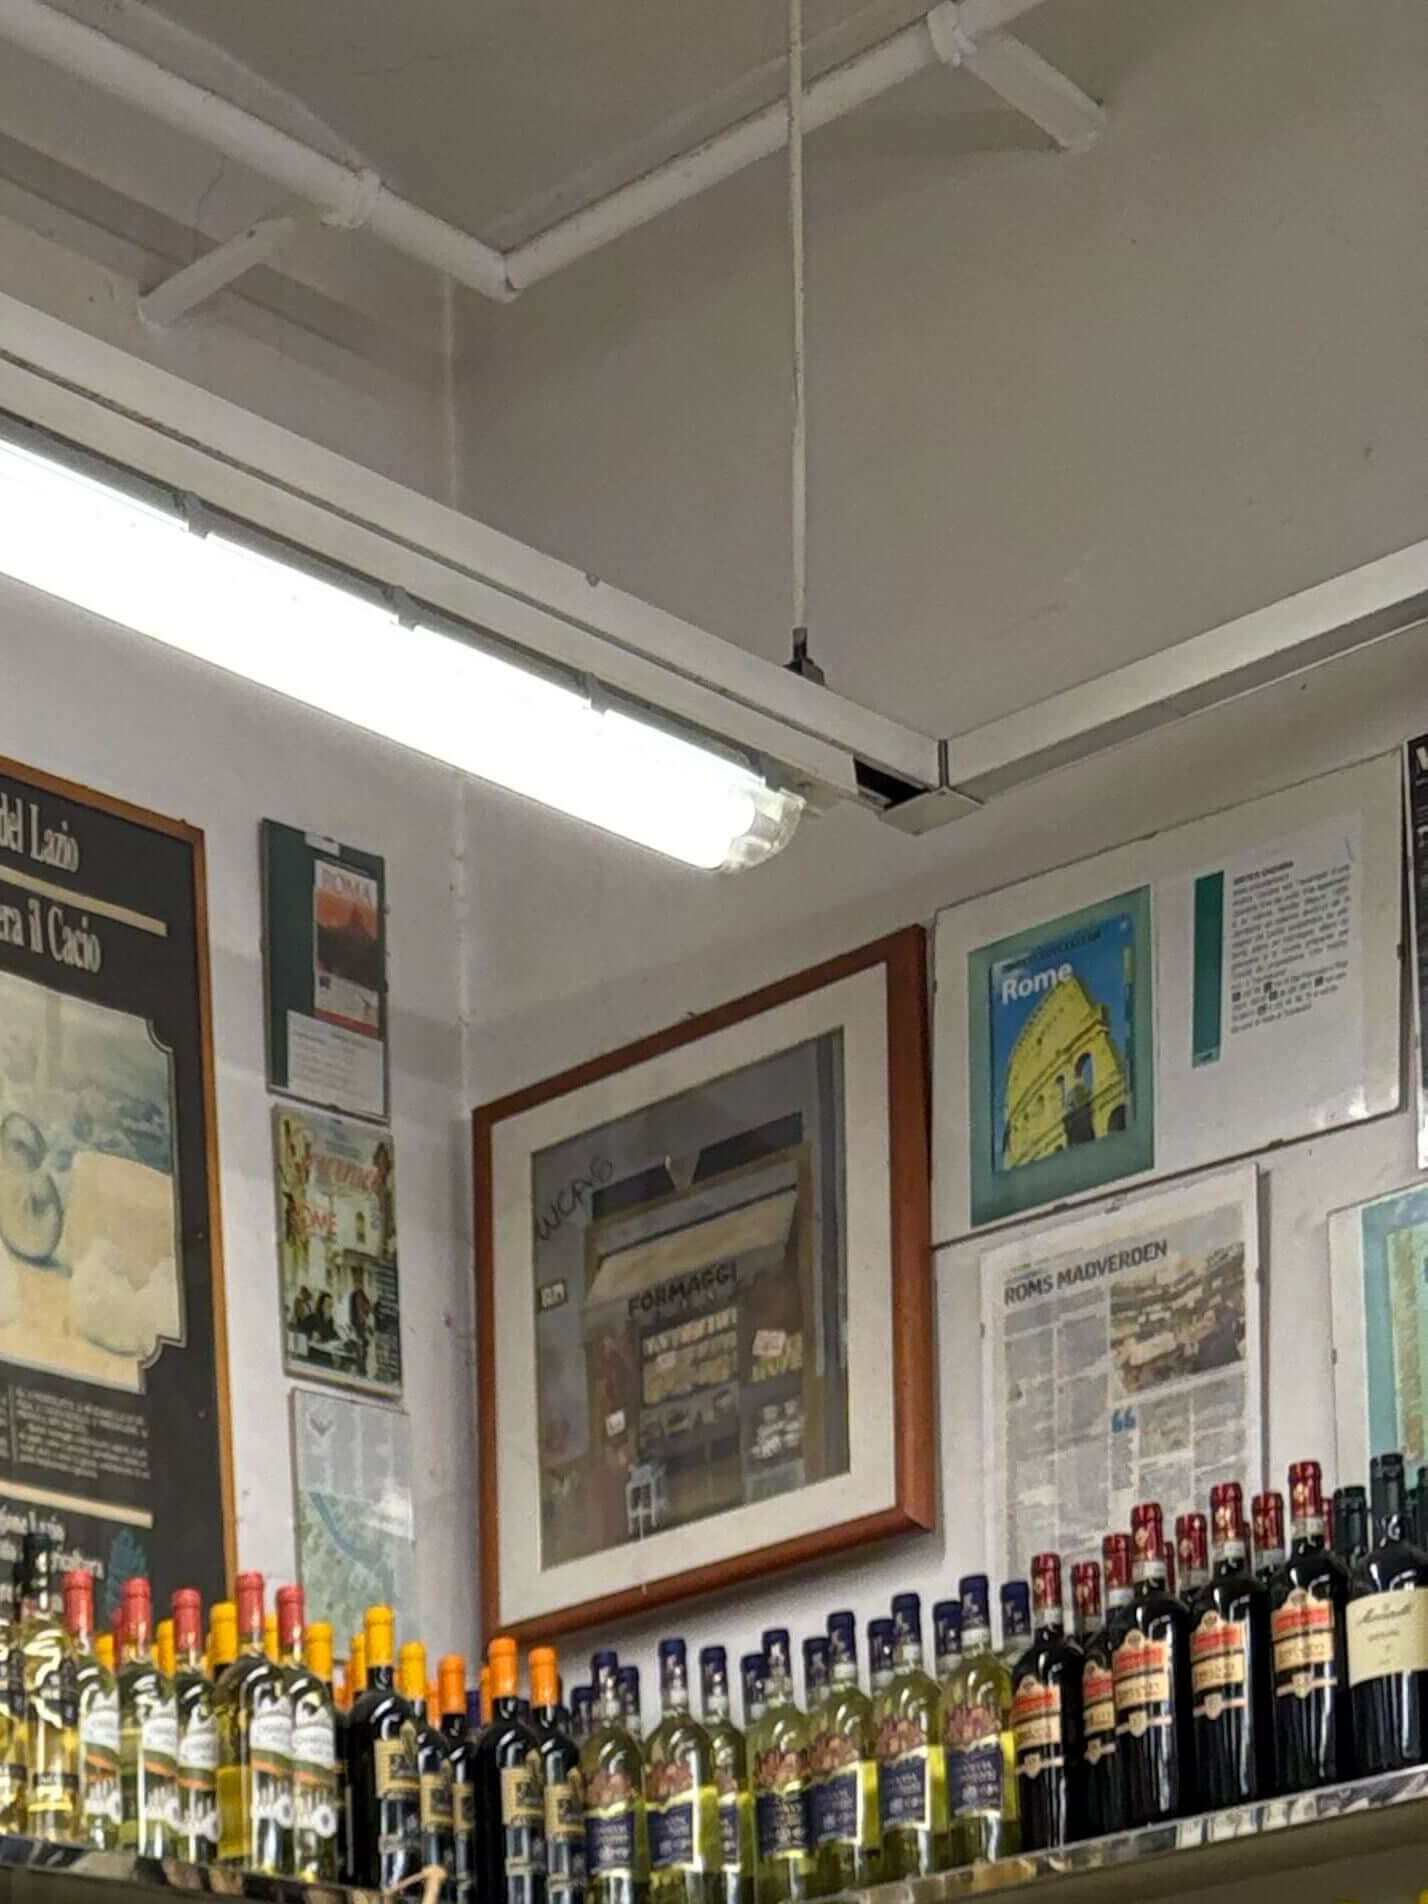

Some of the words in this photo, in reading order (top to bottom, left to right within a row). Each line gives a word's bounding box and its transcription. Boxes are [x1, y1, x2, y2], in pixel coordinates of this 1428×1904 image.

[30, 804, 79, 872] Lazio
[28, 898, 43, 953] il
[48, 906, 101, 973] Cacio
[1001, 960, 1073, 1004] Rome
[628, 1263, 738, 1315] FORMAGGI
[1004, 1275, 1054, 1306] ROMS
[1057, 1240, 1169, 1293] MADVERDEN
